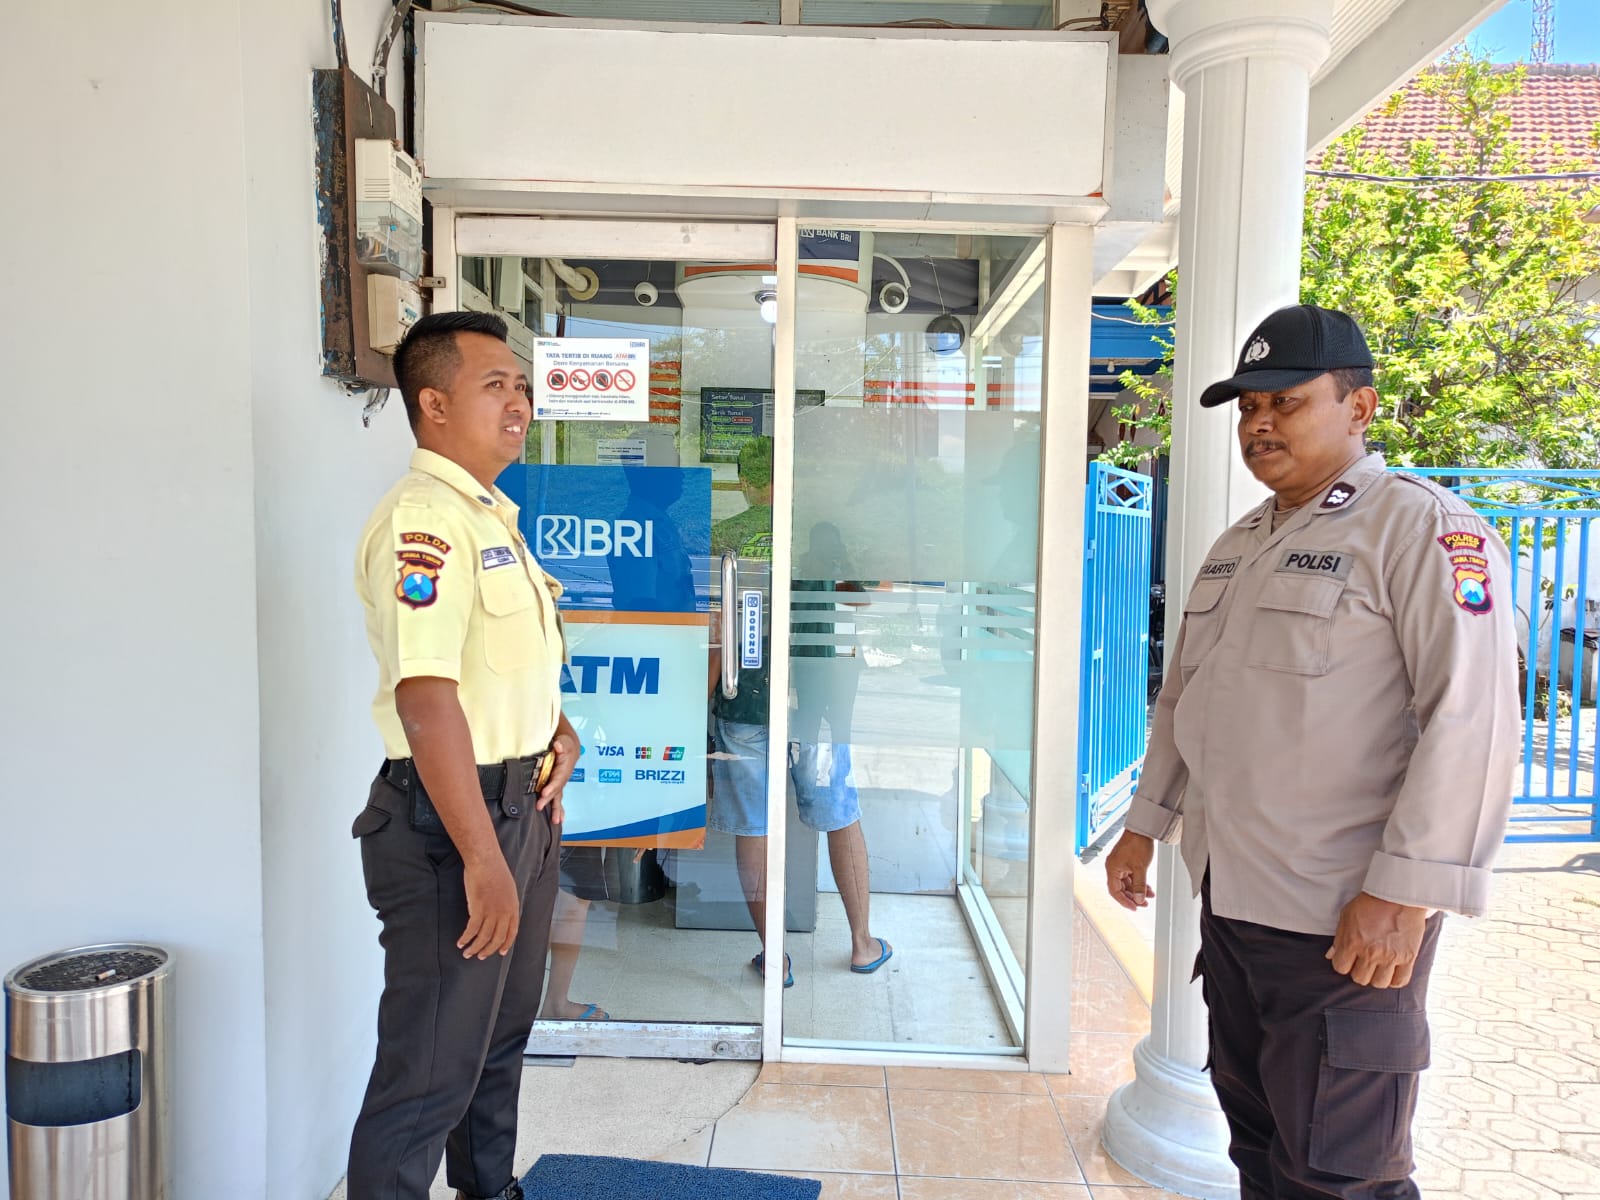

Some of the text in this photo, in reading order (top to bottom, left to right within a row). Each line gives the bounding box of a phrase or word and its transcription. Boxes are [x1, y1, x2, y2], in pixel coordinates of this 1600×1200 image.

[816, 229, 852, 243] BANK BRI
[405, 533, 447, 552] POLDA
[583, 518, 653, 558] BRI
[1285, 553, 1341, 573] POLISI
[748, 610, 756, 655] DORONG
[594, 745, 625, 757] VISA
[635, 769, 685, 781] BRIZZI
